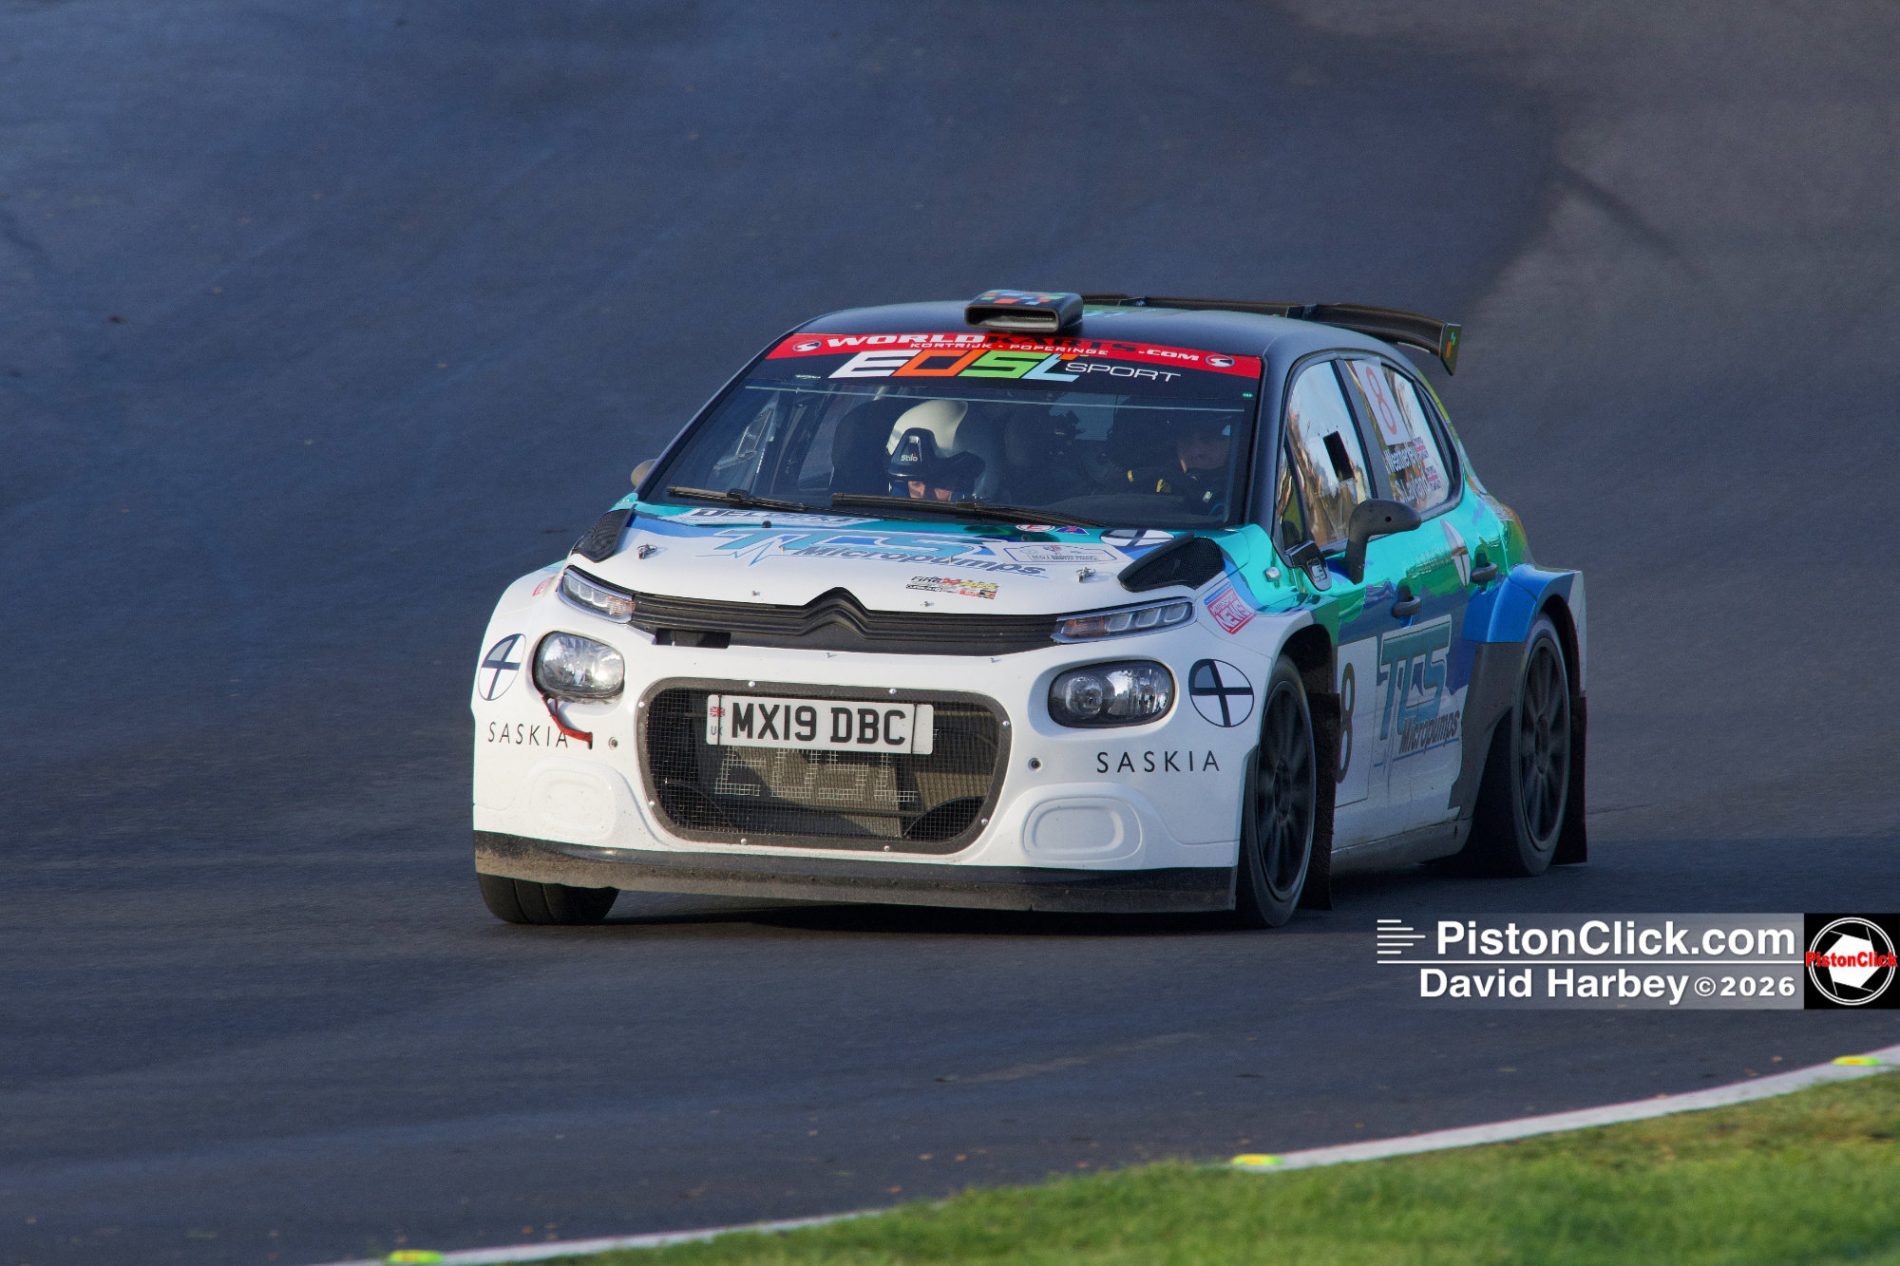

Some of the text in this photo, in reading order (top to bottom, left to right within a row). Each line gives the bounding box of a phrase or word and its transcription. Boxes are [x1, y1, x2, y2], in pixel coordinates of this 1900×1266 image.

[1009, 344, 1109, 355] POPERINGE
[1065, 362, 1181, 382] SPORT
[792, 546, 1047, 576] Micropumps
[487, 721, 569, 749] SASKIA
[731, 702, 906, 746] MX19 DBC
[1096, 750, 1220, 773] SASKIA
